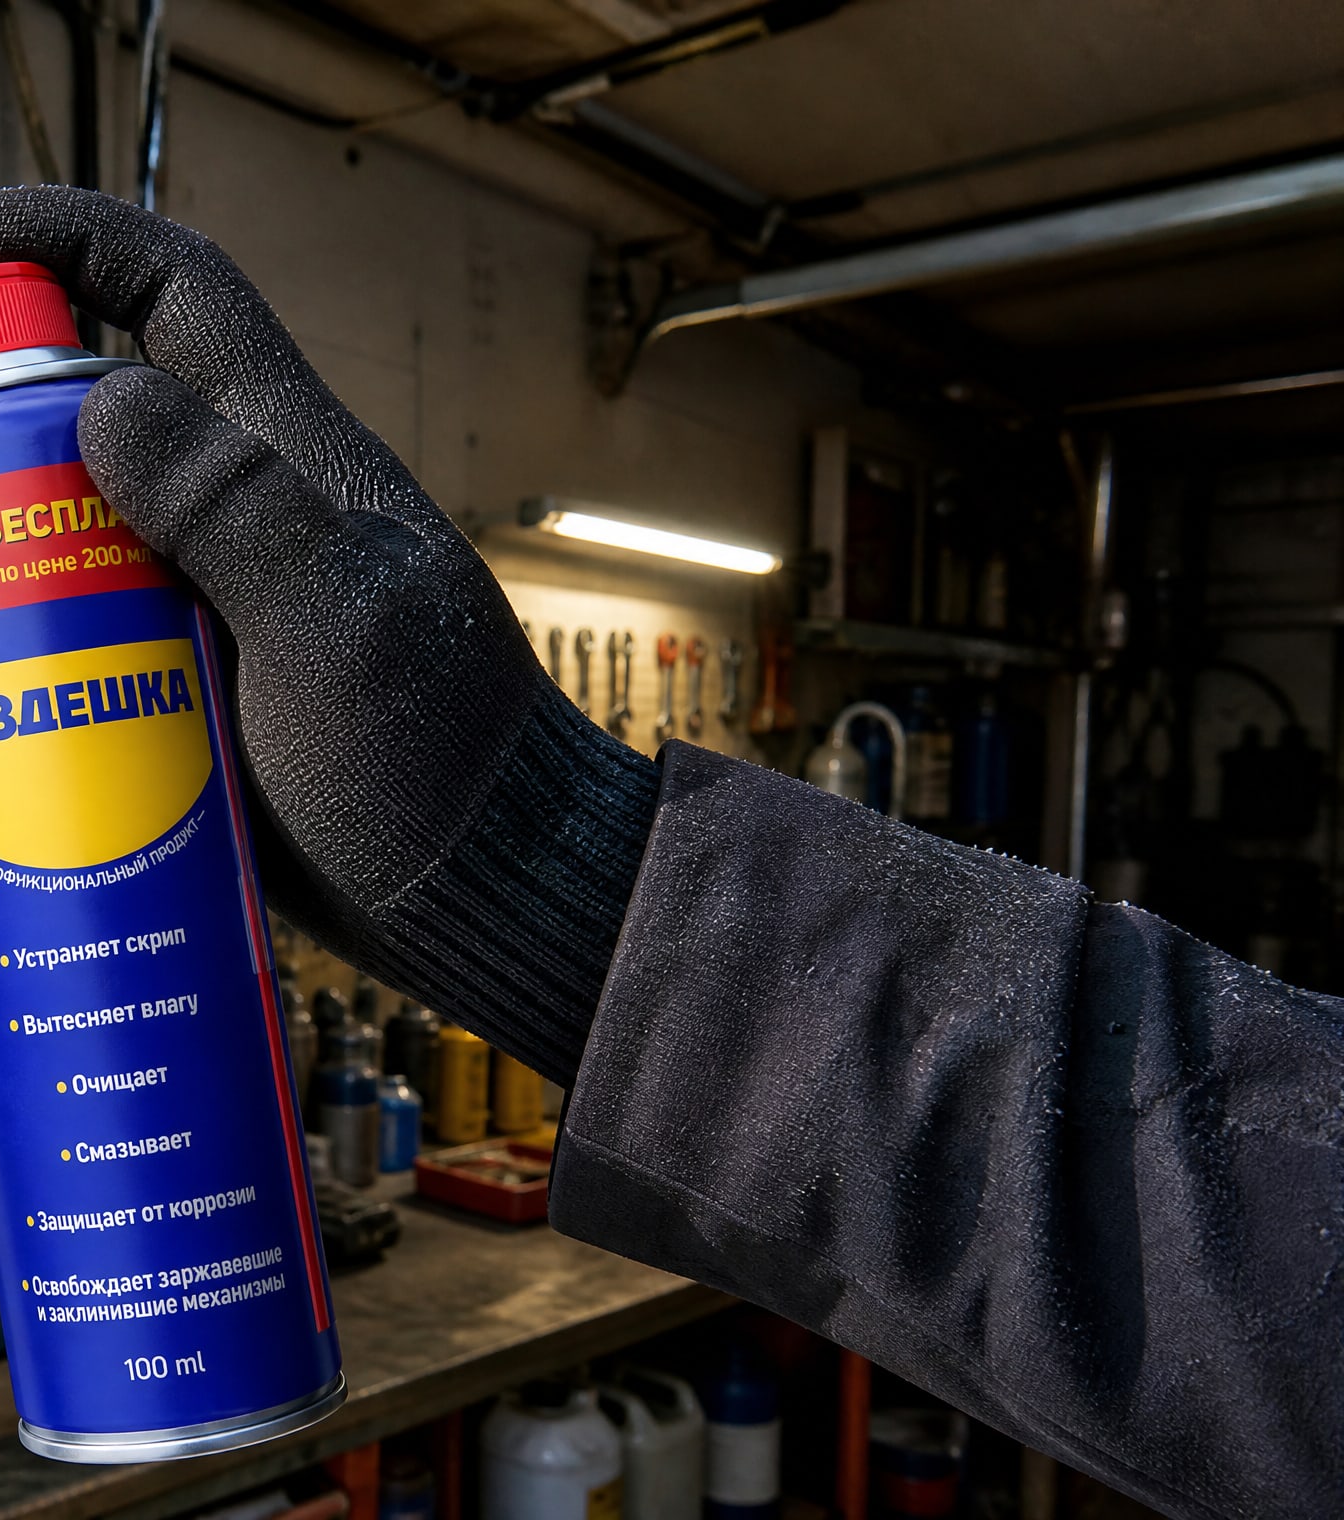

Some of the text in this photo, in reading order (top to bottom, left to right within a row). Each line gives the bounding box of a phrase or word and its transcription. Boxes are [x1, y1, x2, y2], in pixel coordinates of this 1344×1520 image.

[23, 555, 77, 581] цене
[81, 544, 123, 569] 200
[13, 927, 186, 970] Устраняет скрип
[23, 993, 198, 1036] Вытесняет влагу
[72, 1066, 167, 1096] Очищает
[75, 1131, 192, 1164] Смазывает
[37, 1185, 256, 1234] Защищает от коррозии
[32, 1246, 283, 1298] Освобождает заржавевшие
[37, 1272, 286, 1323] и заклинившие механизмы
[124, 1350, 206, 1382] 100 ml
